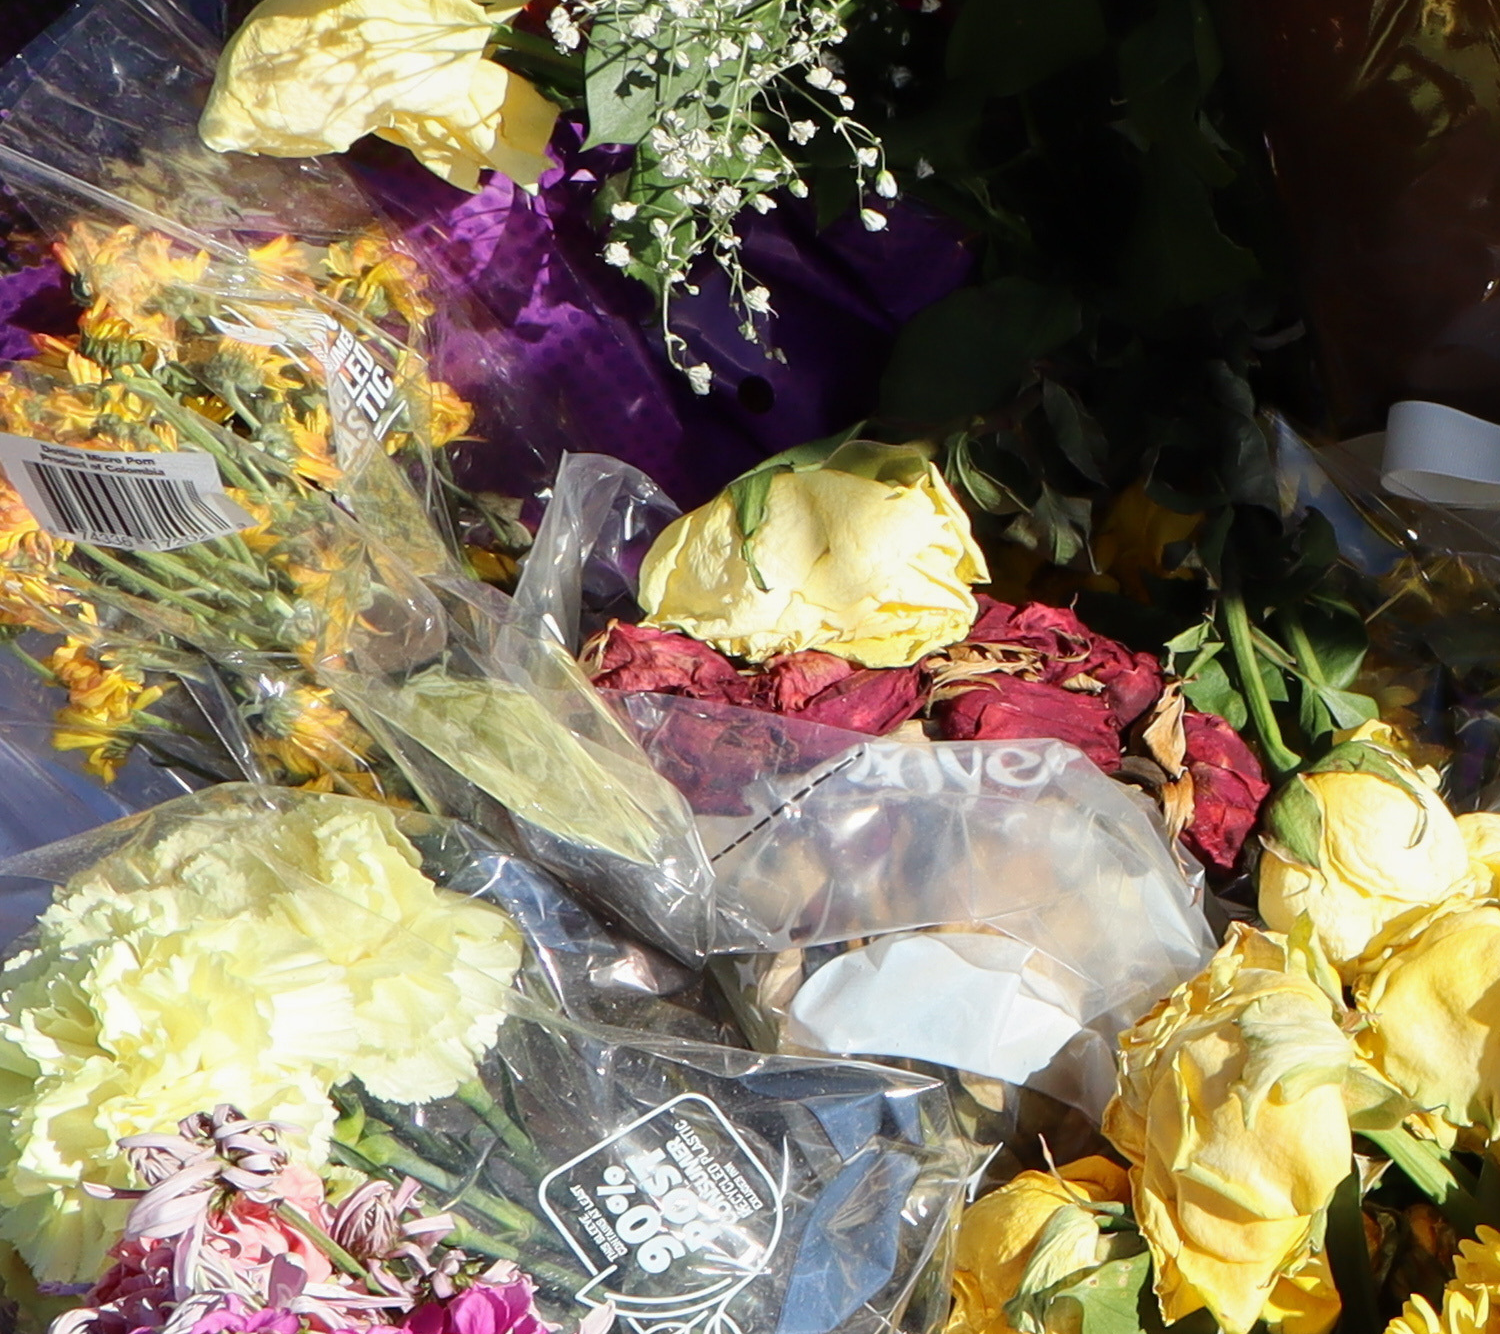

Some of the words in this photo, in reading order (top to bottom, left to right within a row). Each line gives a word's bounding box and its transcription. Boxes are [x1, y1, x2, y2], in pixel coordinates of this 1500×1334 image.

[104, 464, 167, 477] Colombia
[126, 456, 156, 466] Pom
[673, 1118, 711, 1166] PLASTIC
[569, 1183, 592, 1206] LEAST
[625, 1147, 722, 1253] POST
[596, 1165, 687, 1274] 90%
